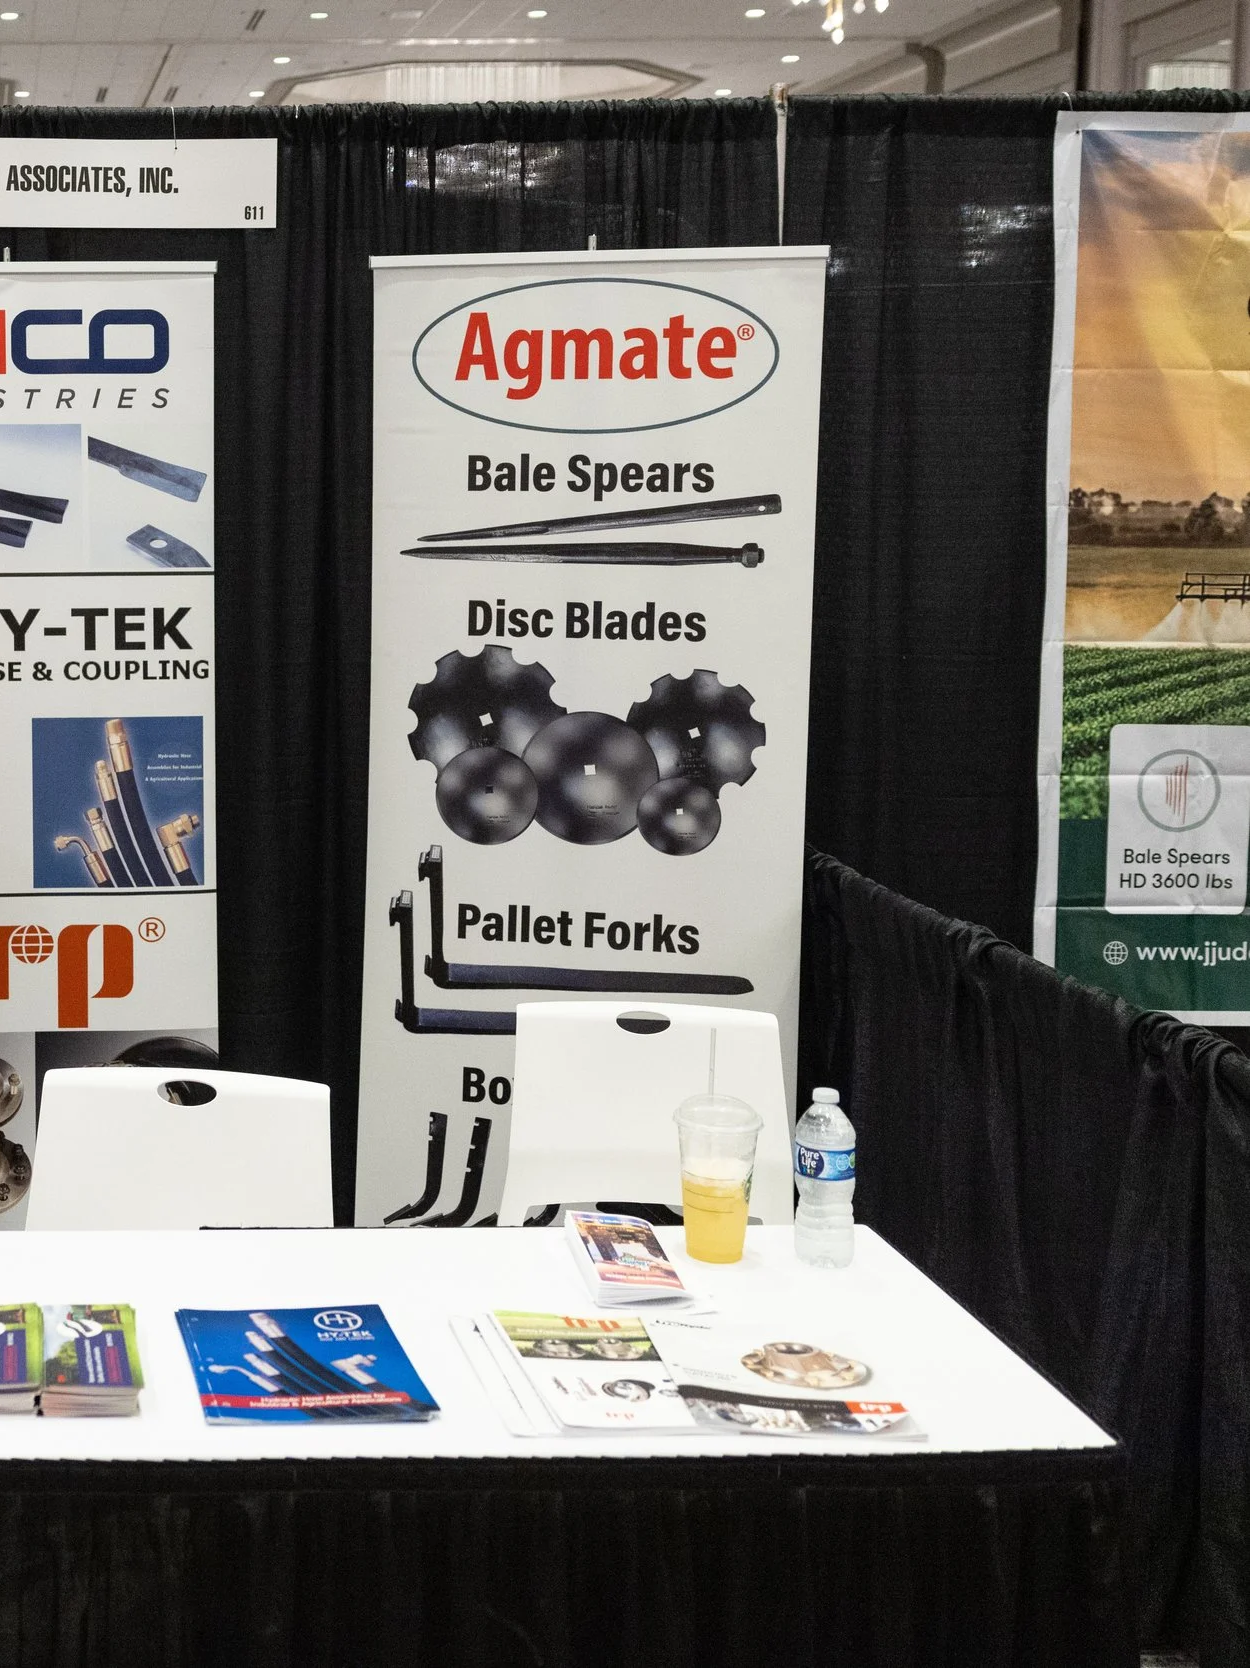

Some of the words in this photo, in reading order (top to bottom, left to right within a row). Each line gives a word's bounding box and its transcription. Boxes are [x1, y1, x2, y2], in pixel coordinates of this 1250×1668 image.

[6, 165, 132, 198] ASSOCIATES,
[139, 167, 179, 194] INC.
[244, 205, 265, 221] 611
[467, 453, 555, 492] Bale
[567, 454, 715, 502] Spears
[467, 599, 553, 638] Disc
[565, 600, 707, 642] Blades
[32, 661, 53, 682] &
[63, 660, 209, 681] COUPLING
[1124, 849, 1161, 864] Bale
[1167, 849, 1230, 867] Spears
[1120, 873, 1146, 888] HD
[1152, 873, 1199, 888] 3600
[1205, 873, 1233, 889] lbs
[457, 903, 572, 947] Pallet
[584, 912, 700, 955] Forks
[1136, 941, 1250, 966] www.jjud
[462, 1066, 514, 1106] Bo
[800, 1147, 820, 1160] Pure
[801, 1157, 817, 1168] Life
